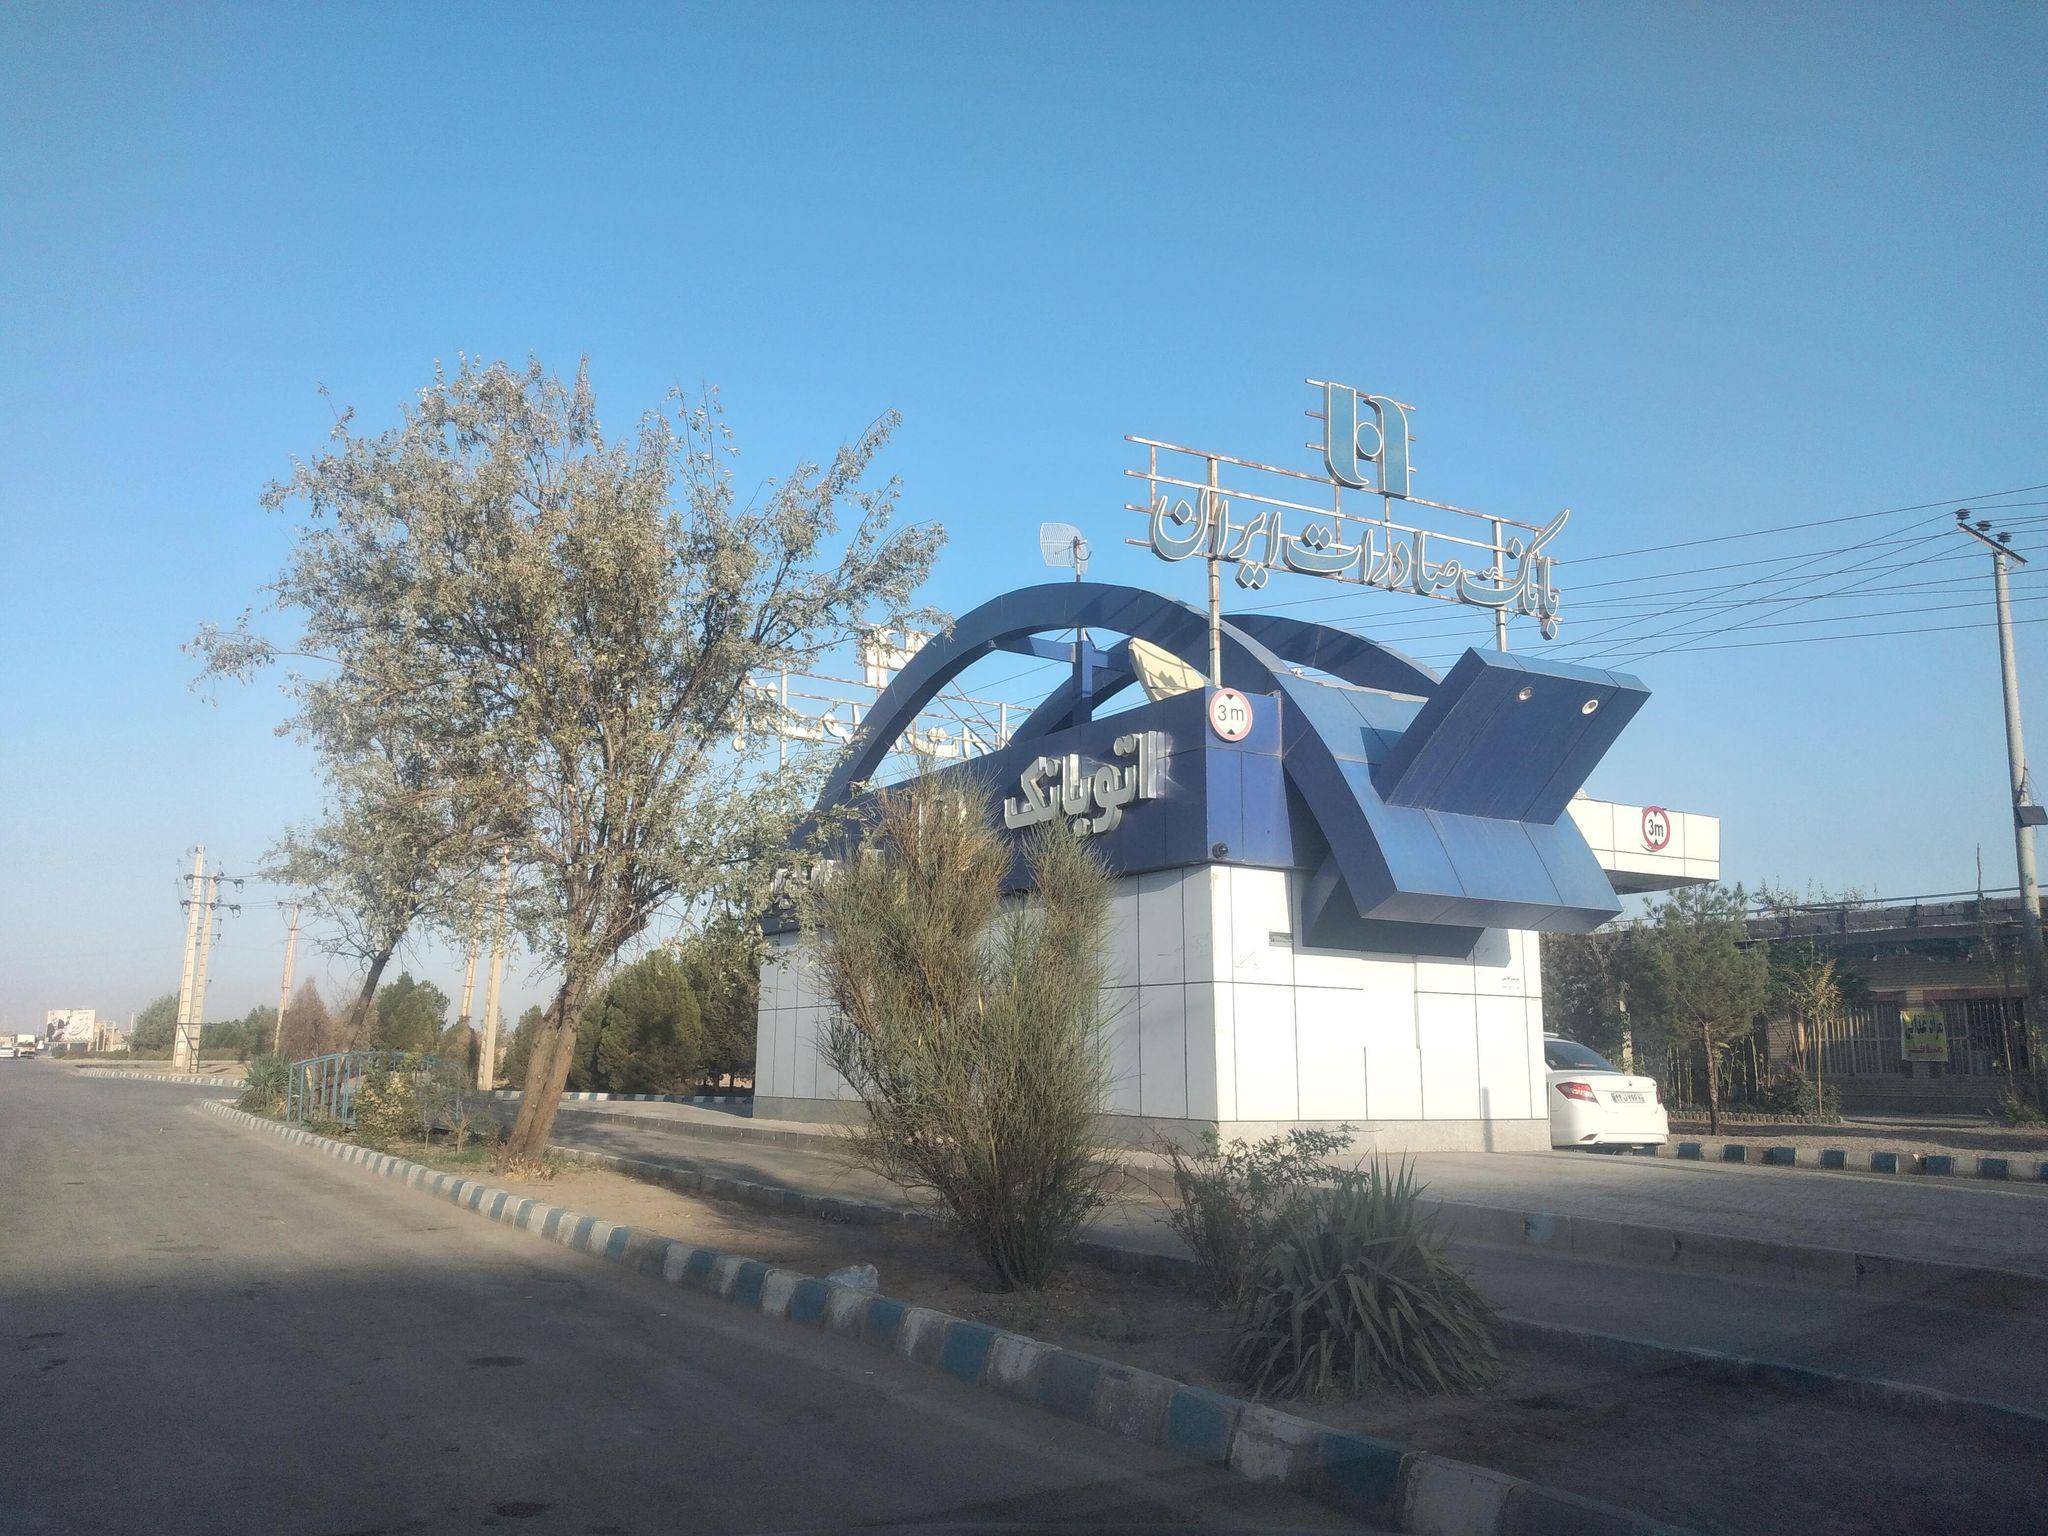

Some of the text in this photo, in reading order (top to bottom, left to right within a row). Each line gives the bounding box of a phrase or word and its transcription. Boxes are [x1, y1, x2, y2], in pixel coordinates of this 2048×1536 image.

[1150, 487, 1571, 640] بانک صادرات ایران
[1004, 730, 1158, 836] اتوبانک
[1648, 818, 1664, 838] 3m
